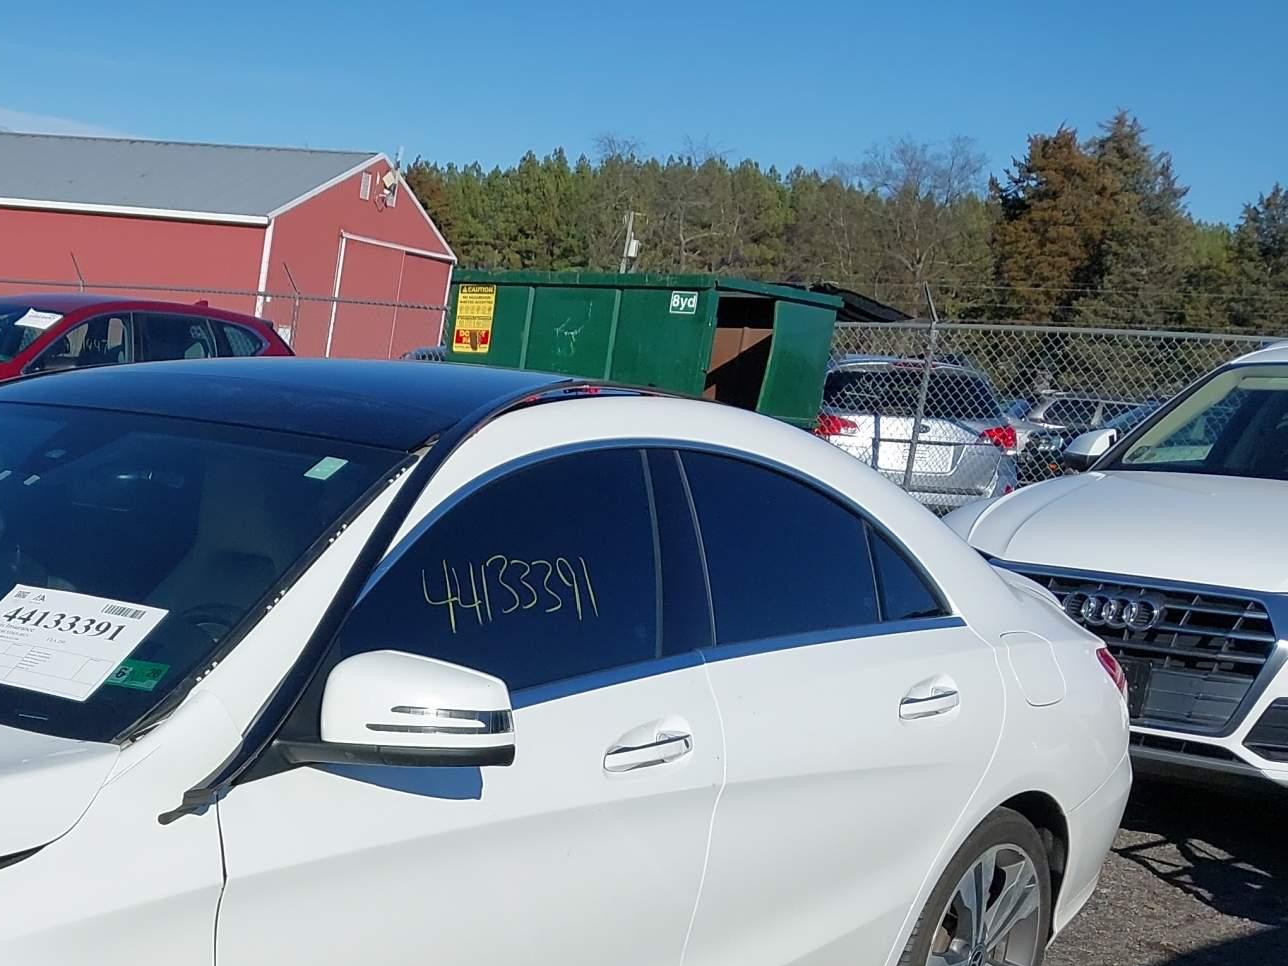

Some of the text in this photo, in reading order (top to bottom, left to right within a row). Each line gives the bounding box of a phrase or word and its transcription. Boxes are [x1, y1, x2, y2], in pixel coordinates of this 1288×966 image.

[672, 294, 697, 311] 8yd
[421, 554, 600, 633] 44133391
[2, 606, 127, 641] 44133391
